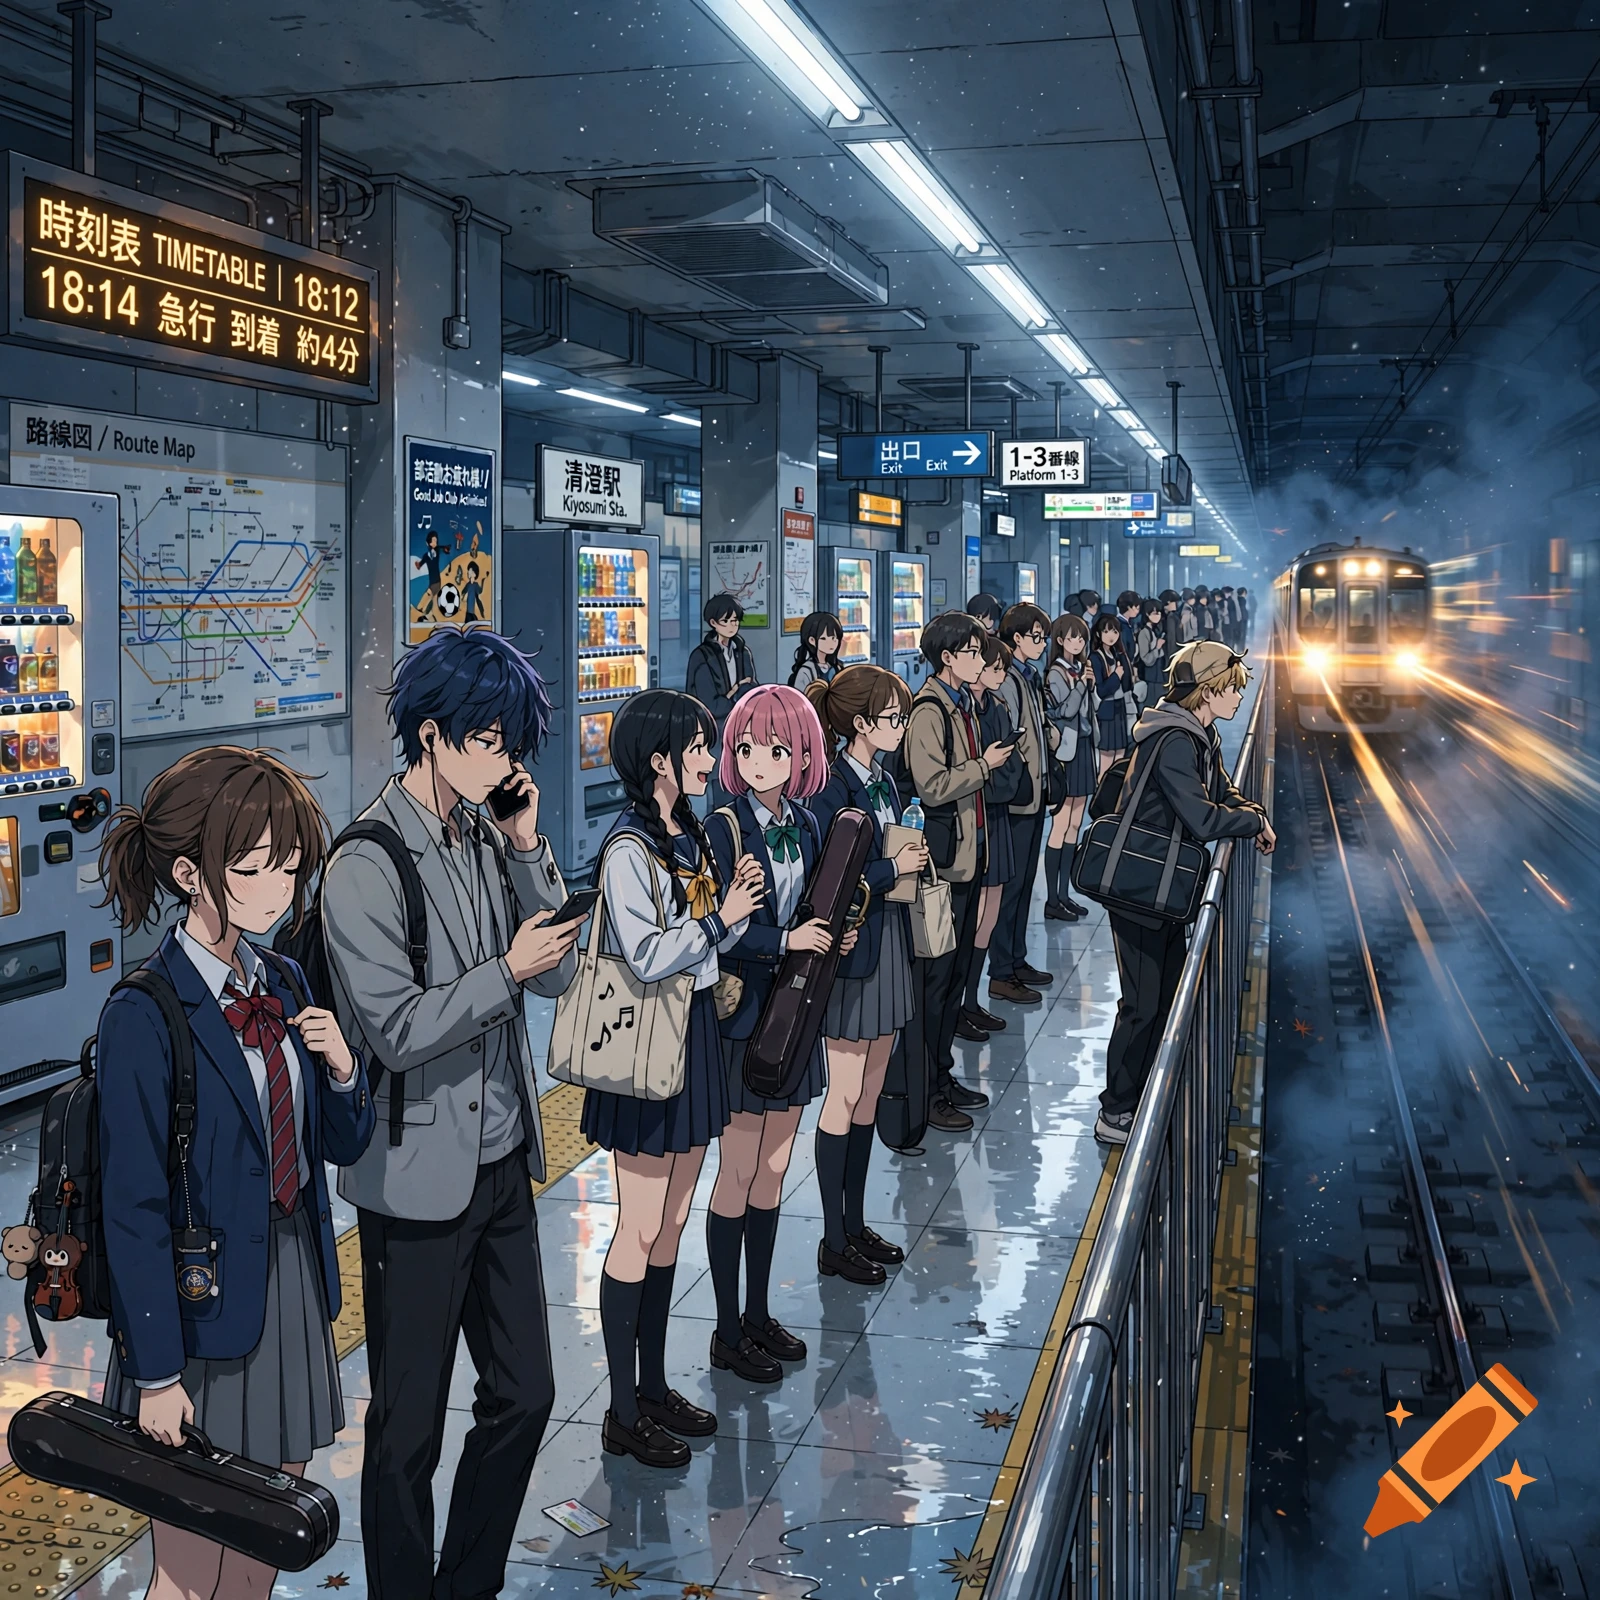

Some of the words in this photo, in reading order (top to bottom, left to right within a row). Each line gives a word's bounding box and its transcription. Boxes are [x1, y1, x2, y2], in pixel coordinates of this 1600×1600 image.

[39, 197, 142, 267] 時刻表
[152, 232, 267, 292] TIMETABLE
[294, 273, 359, 322] 18:12
[41, 265, 139, 326] 18:14
[157, 291, 216, 344] 急行
[230, 309, 281, 358] 到着
[296, 325, 360, 374] 約4分
[26, 416, 92, 452] 路線図
[113, 429, 159, 455] Route
[163, 436, 196, 463] Map
[881, 440, 920, 461] 出口
[881, 461, 903, 474] Exit
[926, 458, 948, 471] Exit
[1010, 446, 1080, 467] 1-3番線
[565, 459, 621, 498] 清澄駅
[1009, 468, 1056, 481] Platform
[1060, 468, 1079, 481] 1-3
[563, 494, 607, 517] Kiyosumi
[609, 500, 628, 518] Sta.
